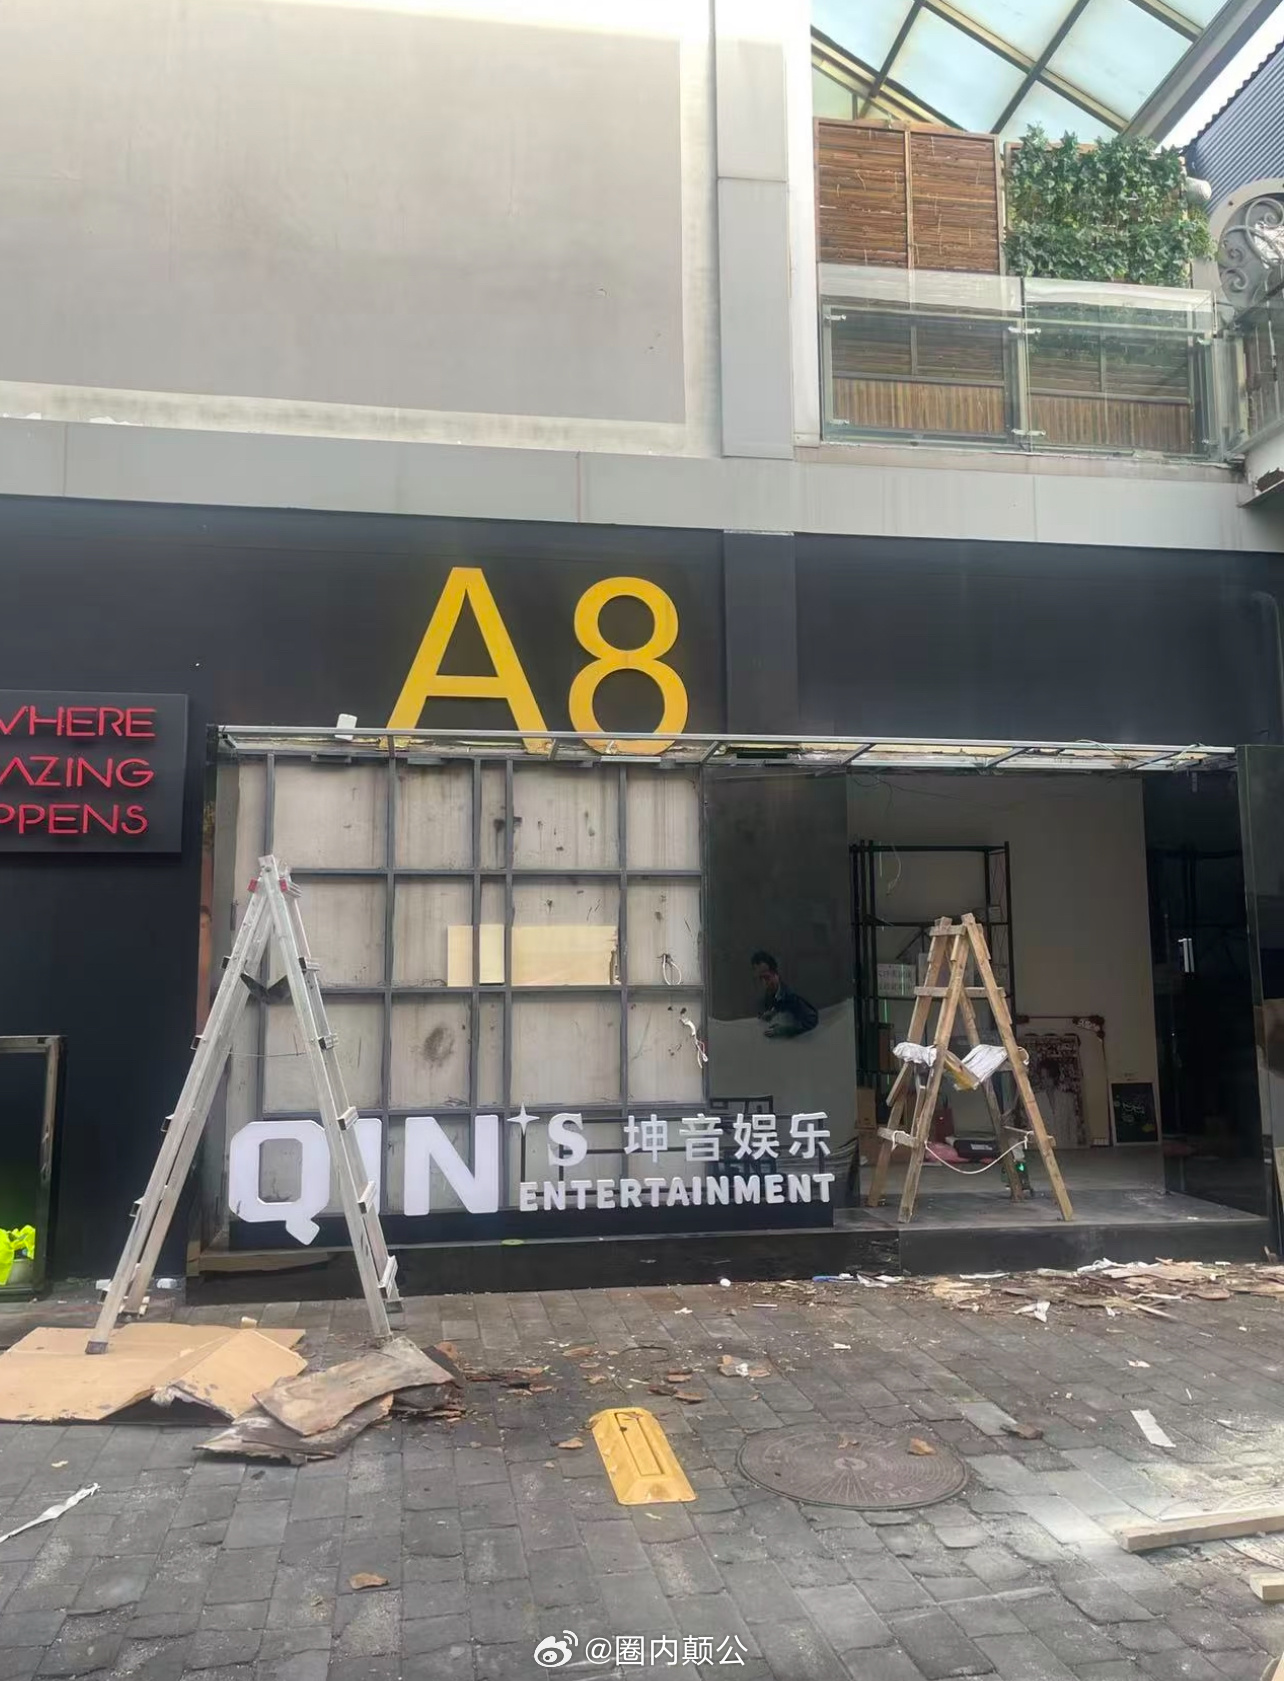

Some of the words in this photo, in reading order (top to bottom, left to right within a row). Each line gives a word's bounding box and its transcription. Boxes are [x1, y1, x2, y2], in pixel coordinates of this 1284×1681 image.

[379, 566, 688, 754] A8
[623, 1112, 831, 1163] 坤音娱乐
[519, 1173, 836, 1212] ENTERTAINMENT
